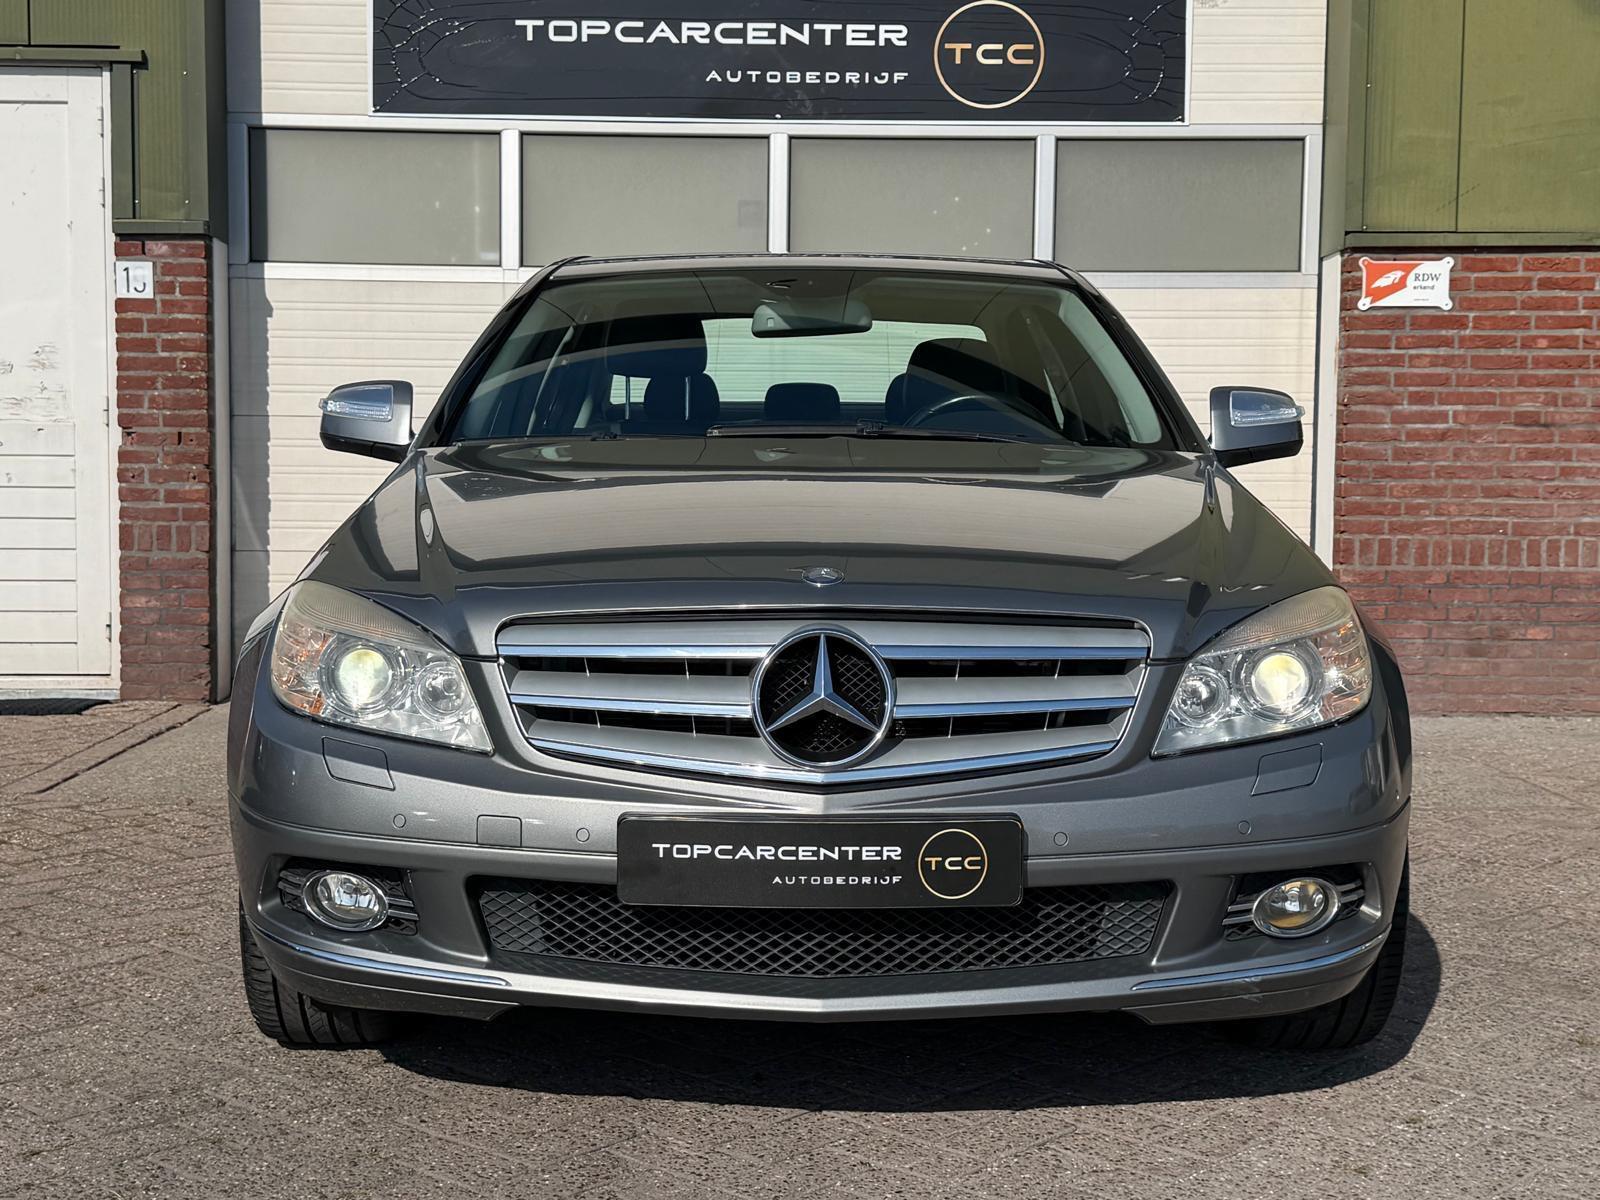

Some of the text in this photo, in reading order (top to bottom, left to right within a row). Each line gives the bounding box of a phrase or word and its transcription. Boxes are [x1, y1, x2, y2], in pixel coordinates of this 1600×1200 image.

[514, 18, 909, 48] TOPCARCENTER
[945, 42, 1035, 65] TCC
[706, 70, 909, 85] AUTOBEDRIJF
[1414, 273, 1441, 281] RDW
[652, 843, 903, 862] TOPCARCENTER
[925, 856, 981, 870] TCC
[772, 875, 903, 885] AUTOBEDRIJF
